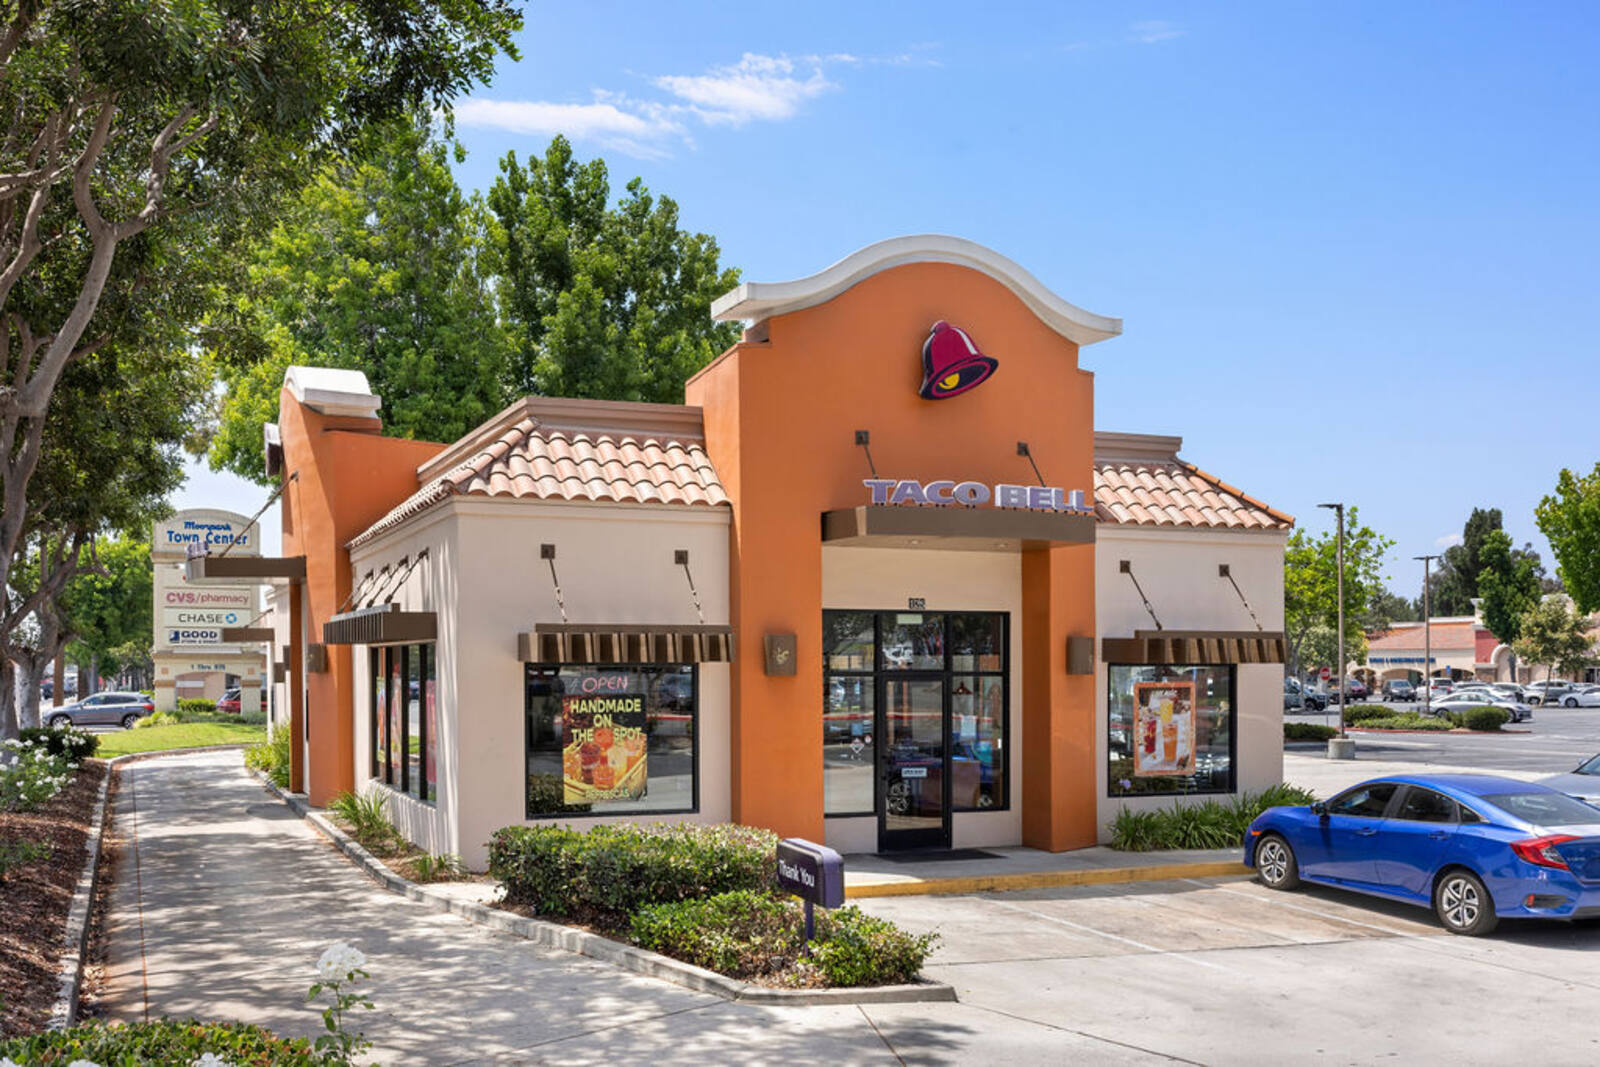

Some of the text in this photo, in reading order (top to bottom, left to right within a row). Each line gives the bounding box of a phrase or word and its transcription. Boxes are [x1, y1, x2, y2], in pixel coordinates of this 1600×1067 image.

[863, 480, 1094, 512] TACO BELL
[167, 530, 248, 545] Town Center
[178, 613, 223, 624] CHASE
[582, 675, 629, 693] OPEN
[570, 699, 641, 713] HANDMADE
[593, 714, 612, 728] ON
[571, 727, 642, 742] THE SPOT
[779, 859, 815, 888] Thank You
